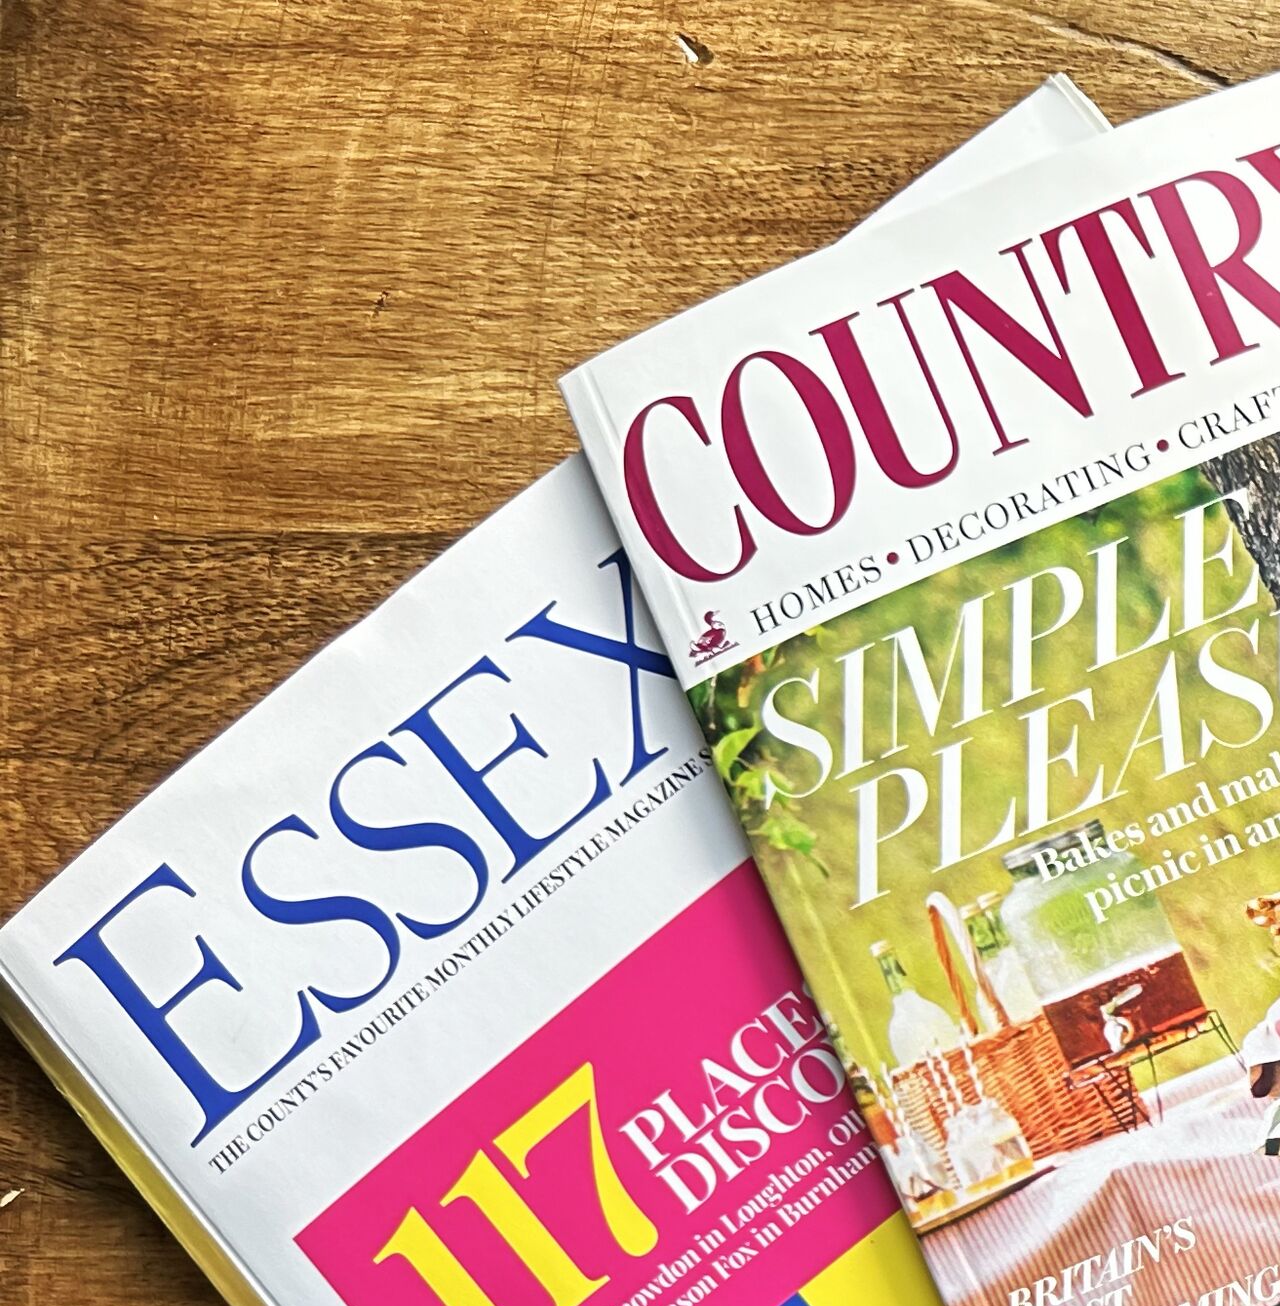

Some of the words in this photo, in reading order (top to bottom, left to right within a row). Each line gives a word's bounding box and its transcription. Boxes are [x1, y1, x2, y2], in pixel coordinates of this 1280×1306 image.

[750, 552, 882, 635] HOMES
[909, 440, 1154, 565] DECORATING
[763, 488, 1261, 809] SIMPLE
[52, 548, 677, 1148] ESSEX
[1029, 817, 1145, 884] Bakes
[1143, 777, 1219, 836] and
[1084, 849, 1202, 924] picnic
[1199, 831, 1244, 879] in
[208, 1134, 252, 1175] THE
[246, 1061, 333, 1146] COUNTY'S
[329, 982, 431, 1073] FAVOURITE
[424, 908, 518, 993] MONTHLY
[511, 832, 610, 919] LIFESTYLE
[603, 758, 706, 844] MAGAZINE
[654, 1036, 846, 1216] DISCO
[693, 1229, 727, 1257] in
[711, 1242, 760, 1281] Fox
[749, 1219, 784, 1249] in
